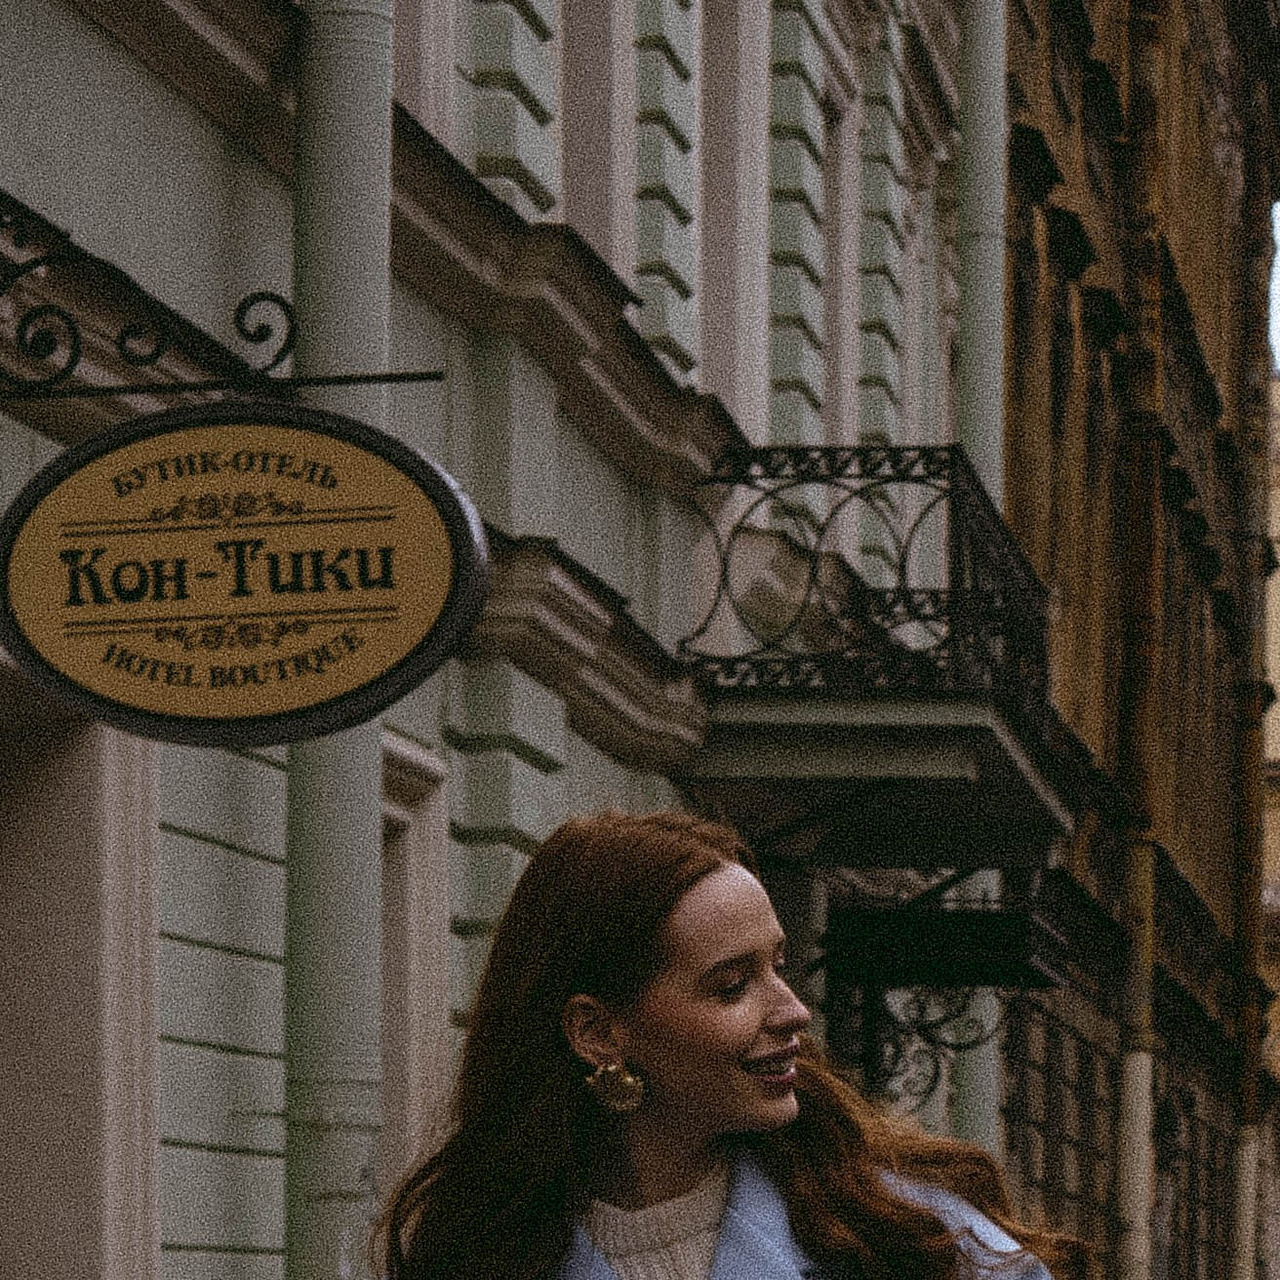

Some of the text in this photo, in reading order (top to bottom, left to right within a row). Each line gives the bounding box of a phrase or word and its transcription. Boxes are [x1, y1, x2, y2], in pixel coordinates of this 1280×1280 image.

[112, 450, 339, 498] БУТИК-ОТЕЛЬ
[58, 538, 396, 607] Кон-Тики
[101, 627, 365, 688] HOTEL BOUTIQUE
